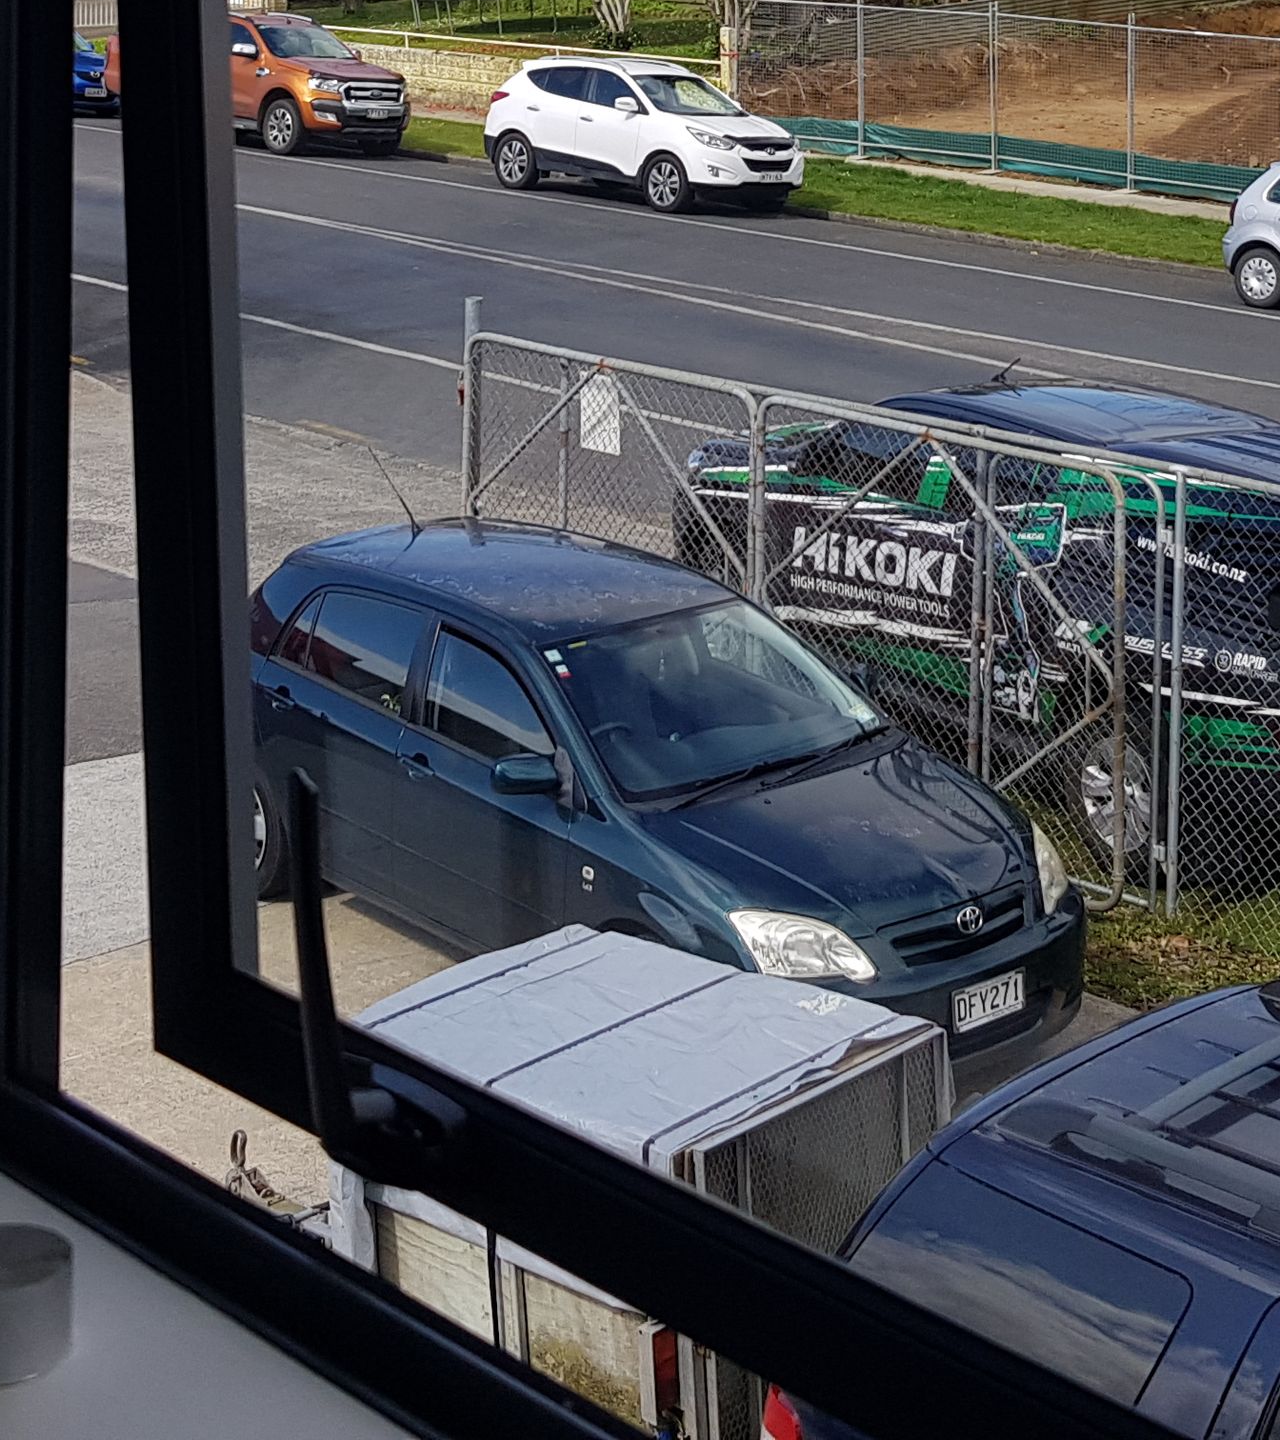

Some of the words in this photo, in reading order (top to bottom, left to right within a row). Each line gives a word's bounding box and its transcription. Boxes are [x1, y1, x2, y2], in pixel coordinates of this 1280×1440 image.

[790, 573, 815, 589] HIGH
[815, 579, 883, 606] PERFORMANCE
[883, 591, 918, 612] POWER
[917, 598, 951, 620] TOOLS
[1232, 651, 1267, 671] RAPID
[956, 977, 1019, 1023] DFY271
